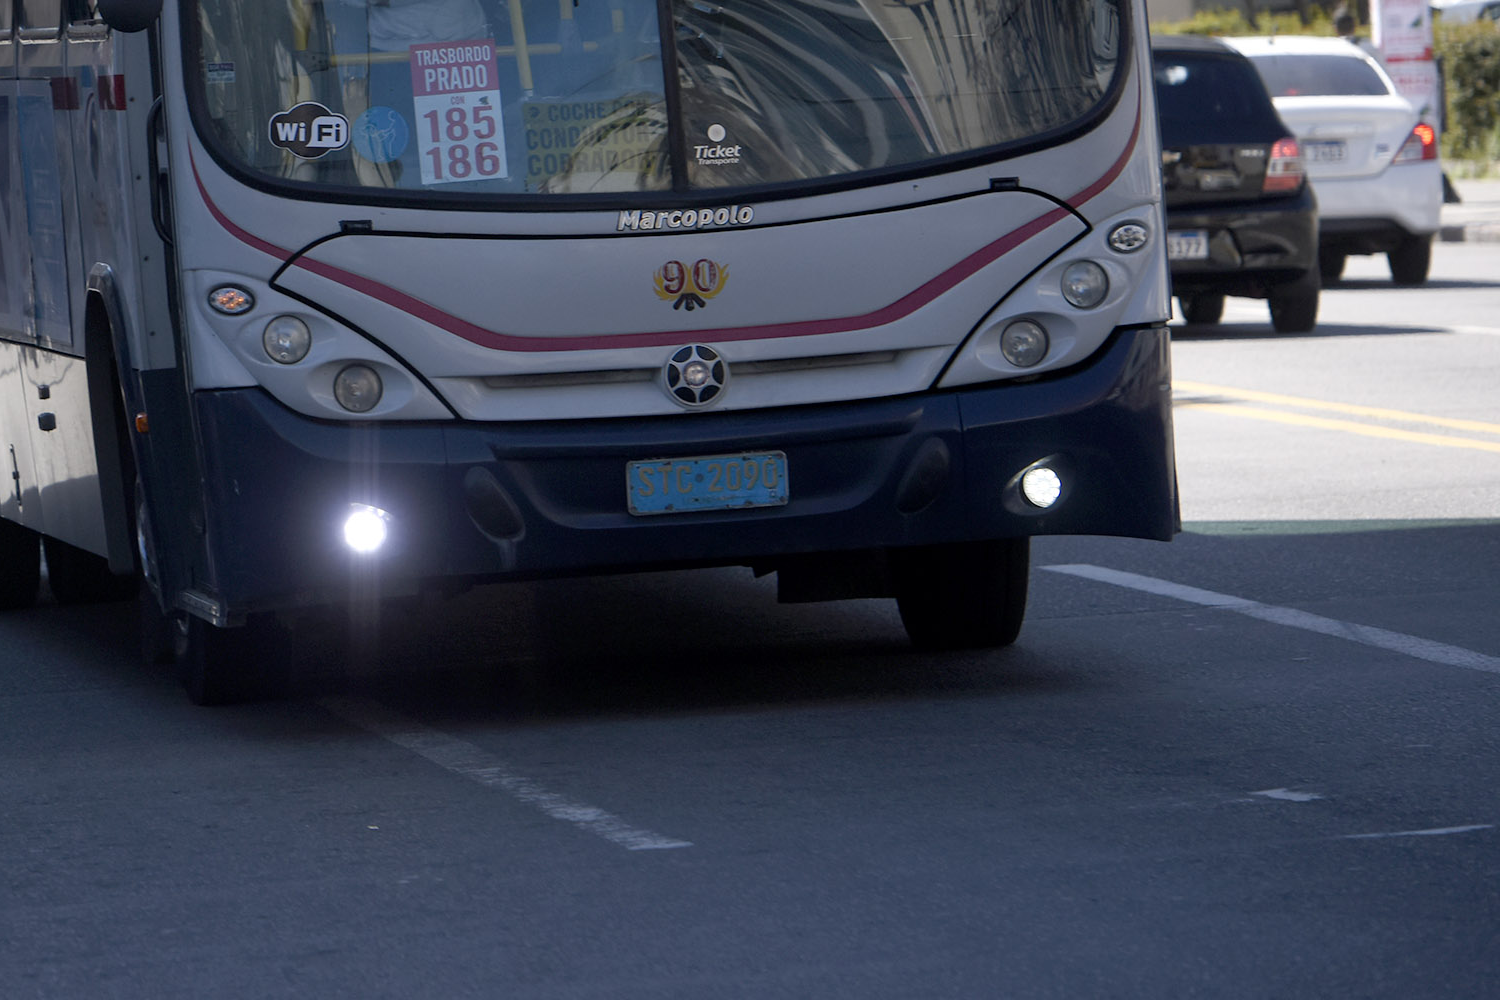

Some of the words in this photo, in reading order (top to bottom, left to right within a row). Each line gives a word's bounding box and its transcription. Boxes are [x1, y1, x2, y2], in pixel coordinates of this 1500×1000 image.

[414, 45, 492, 67] TRASBORDO
[424, 64, 489, 92] PRADO
[423, 105, 497, 143] 185
[548, 102, 606, 122] COCHE
[426, 141, 501, 180] 186
[693, 144, 743, 159] Ticket
[617, 205, 755, 232] Marcopolo
[663, 258, 717, 294] 90
[637, 464, 693, 497] STC
[707, 459, 779, 492] 2090
